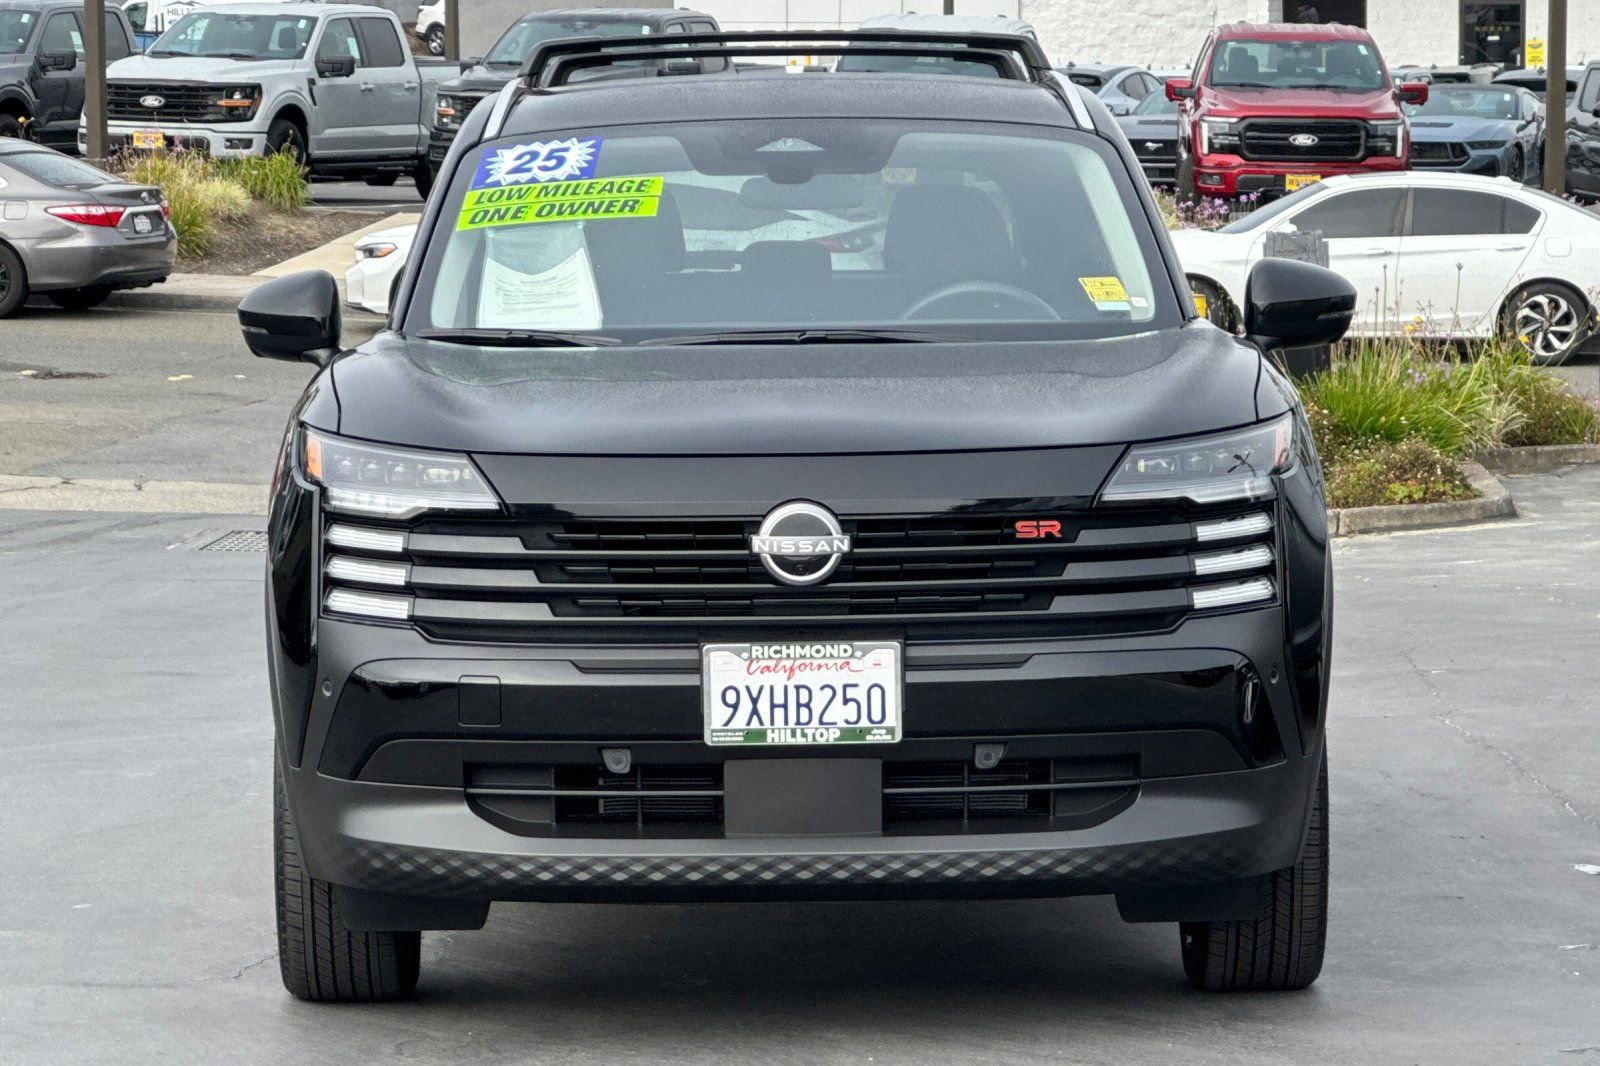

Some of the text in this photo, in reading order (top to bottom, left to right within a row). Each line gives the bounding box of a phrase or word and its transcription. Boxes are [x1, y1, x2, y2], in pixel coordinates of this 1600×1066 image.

[505, 146, 571, 175] 25
[474, 178, 655, 206] LOW MILEAGE
[468, 198, 643, 225] ONE OWNER
[1015, 520, 1062, 539] SR
[754, 538, 848, 553] NISSAN
[751, 644, 853, 659] RICHMOND
[746, 658, 864, 681] California
[721, 683, 886, 727] 9XHB250
[766, 728, 841, 743] HILLTOP
